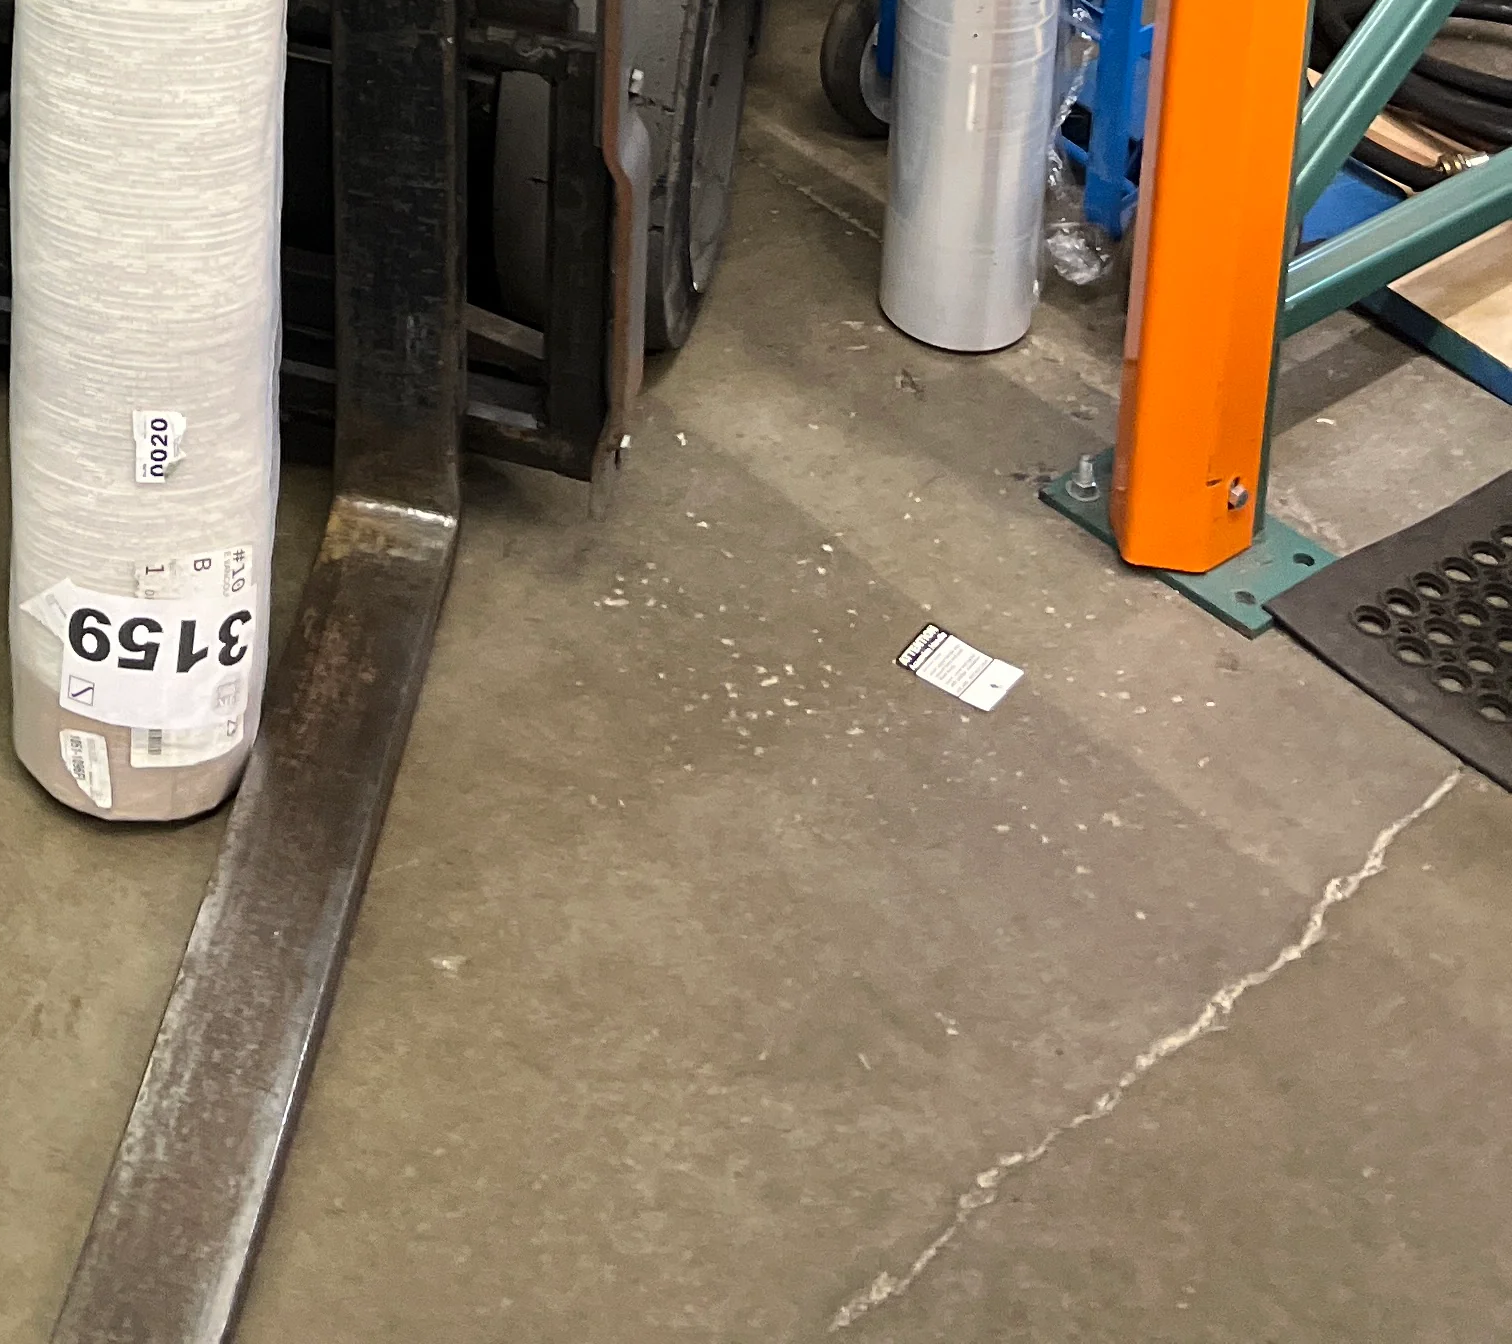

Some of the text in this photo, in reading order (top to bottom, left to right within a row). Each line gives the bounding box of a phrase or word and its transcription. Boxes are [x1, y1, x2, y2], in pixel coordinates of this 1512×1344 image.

[145, 564, 165, 575] 1
[194, 558, 212, 572] B
[231, 549, 246, 593] #10
[68, 607, 253, 674] 3159
